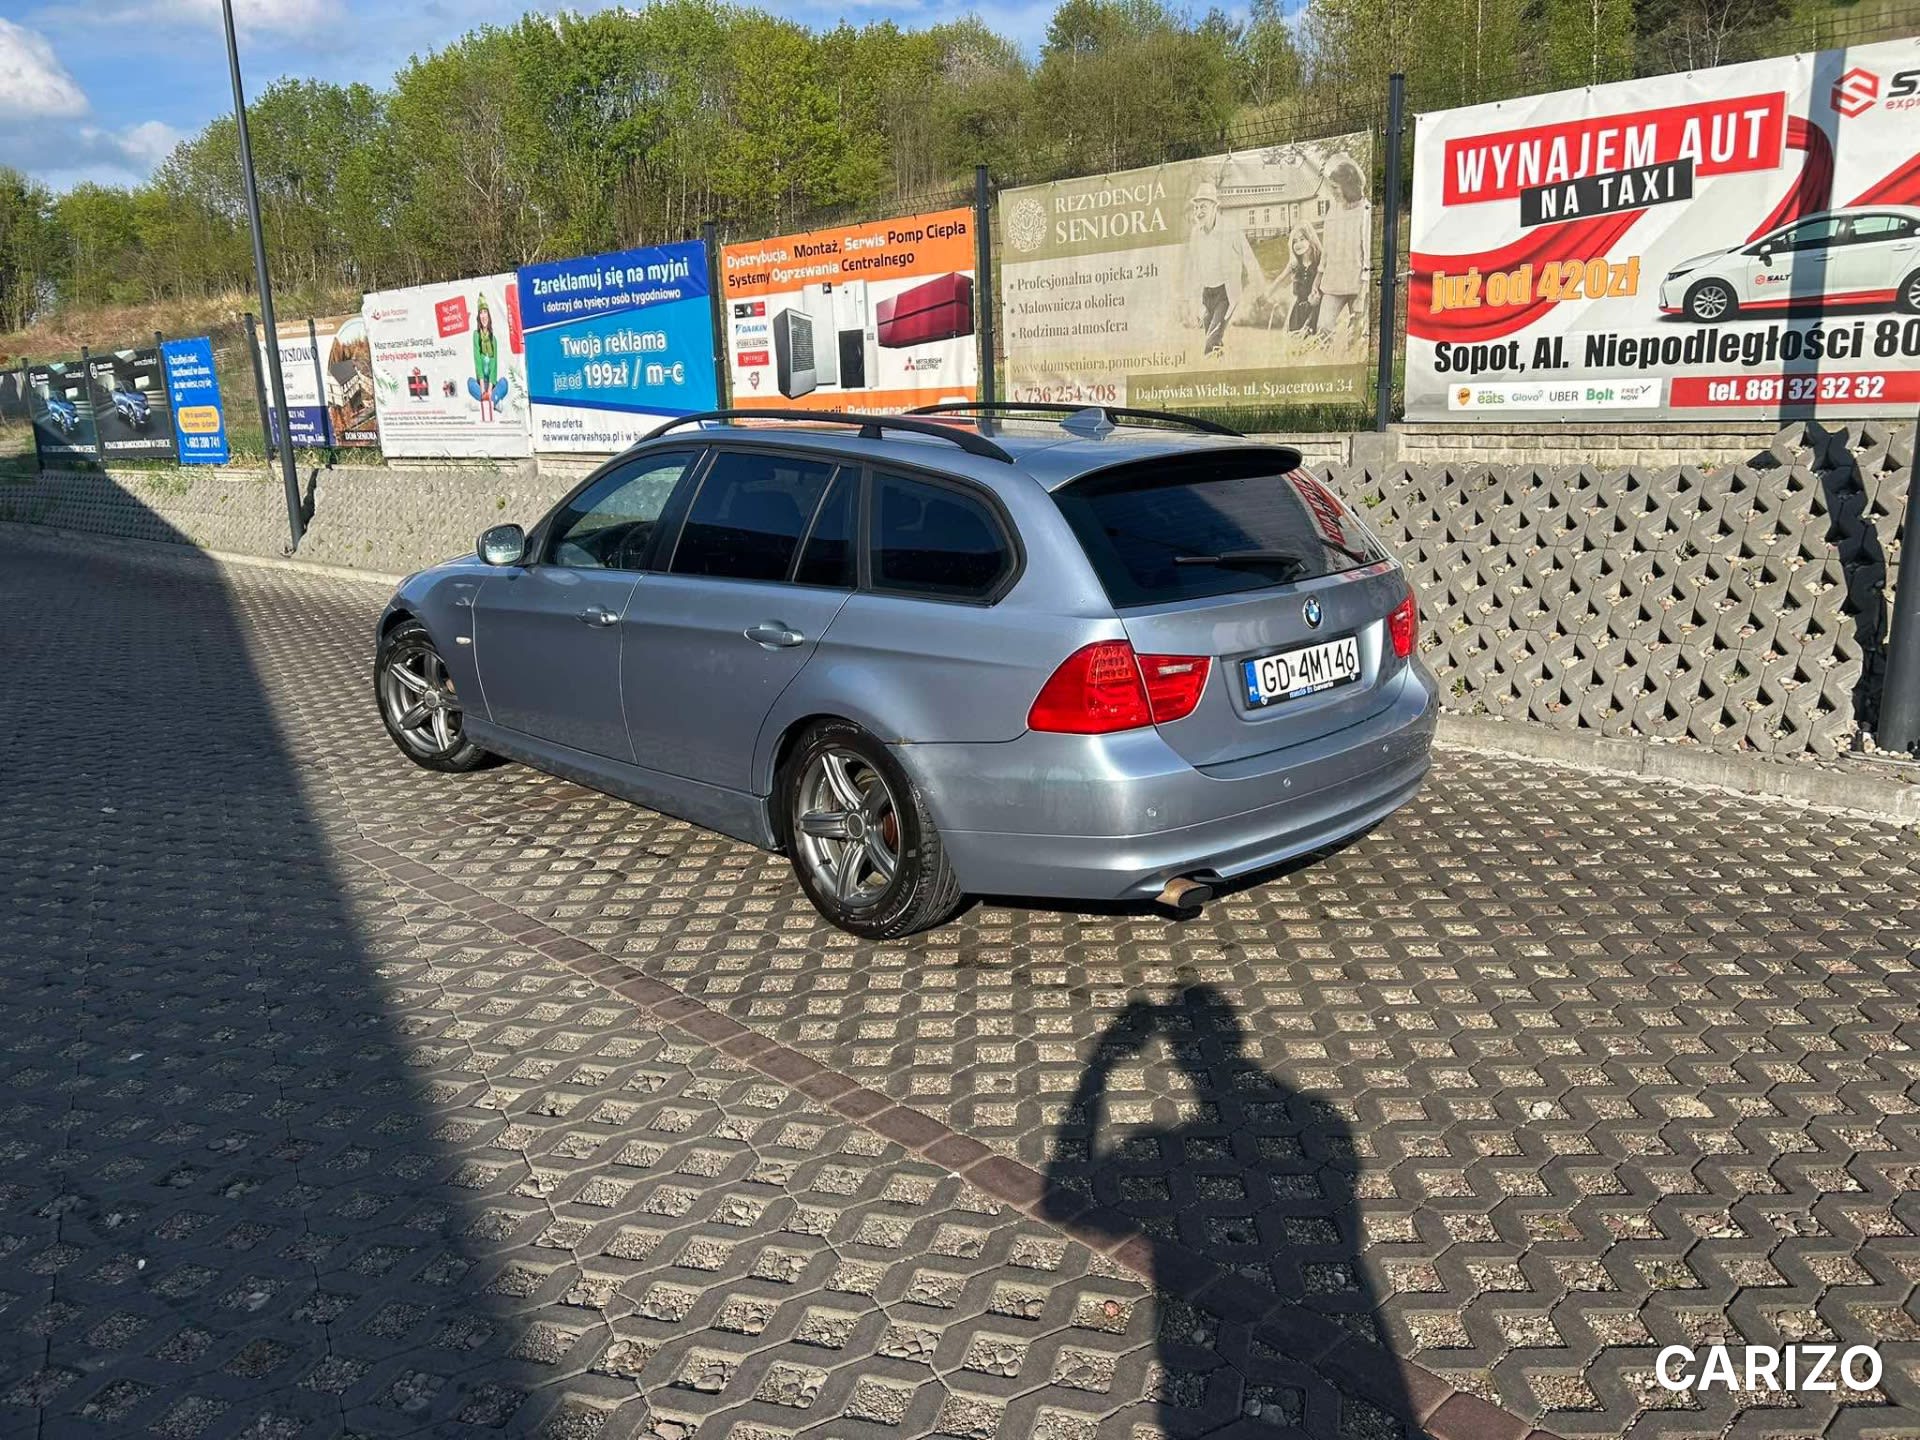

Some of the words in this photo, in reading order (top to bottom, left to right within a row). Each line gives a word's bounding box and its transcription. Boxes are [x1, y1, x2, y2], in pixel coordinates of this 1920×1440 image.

[1456, 123, 1657, 194] WYNAJEM
[1677, 108, 1769, 166] AUT
[1055, 182, 1166, 213] REZYDENCJA
[1540, 185, 1580, 219] NA
[1598, 166, 1675, 208] TAXI
[793, 240, 841, 258] Montaż,
[844, 233, 886, 251] Serwis
[888, 230, 923, 244] Pomp
[926, 221, 966, 239] Ciepła
[1056, 207, 1168, 244] SENIORA
[532, 268, 601, 295] Zareklamuj
[605, 266, 624, 288] się
[627, 267, 643, 283] na
[647, 257, 689, 283] myjni
[729, 272, 771, 288] Systemy
[771, 261, 839, 283] Ogrzewania
[842, 252, 914, 271] Centralnego
[1017, 271, 1092, 291] Profesjonalna
[1095, 267, 1133, 285] opieka
[1136, 263, 1158, 279] 24h
[1429, 266, 1482, 314] już
[1486, 263, 1533, 307] od
[1536, 256, 1640, 303] 420zł
[547, 301, 572, 312] dotrzyj
[574, 298, 583, 308] do
[612, 293, 630, 305] osób
[631, 288, 681, 305] tygodniowo
[1084, 293, 1125, 308] okolica
[560, 332, 601, 360] Twoja
[605, 328, 667, 353] reklama
[1019, 324, 1069, 340] Rodzinna
[1071, 319, 1128, 336] atmosfera
[1434, 340, 1525, 374] Sopot,
[1532, 336, 1569, 369] Al.
[1584, 321, 1865, 369] Niepodległości
[568, 370, 582, 389] od
[583, 359, 629, 388] 199zł
[646, 361, 685, 386] m-c
[1012, 351, 1187, 374] www.domseniora.pomorskie.pl
[1025, 387, 1050, 403] 736
[1056, 385, 1082, 402] 254
[1087, 384, 1116, 401] 708
[1244, 381, 1260, 396] ul.
[1263, 380, 1333, 397] Spacerowa
[1337, 378, 1353, 392] 34
[1477, 392, 1504, 404] eats
[1550, 391, 1578, 402] UBER
[1586, 388, 1614, 401] Bolt
[1708, 380, 1742, 402] tel.
[1745, 378, 1783, 401] 881
[1788, 378, 1817, 400] 32
[1821, 376, 1850, 399] 32
[1853, 375, 1884, 398] 32
[562, 418, 583, 429] oferta
[1262, 658, 1290, 693] GD
[1299, 640, 1355, 683] 4M146
